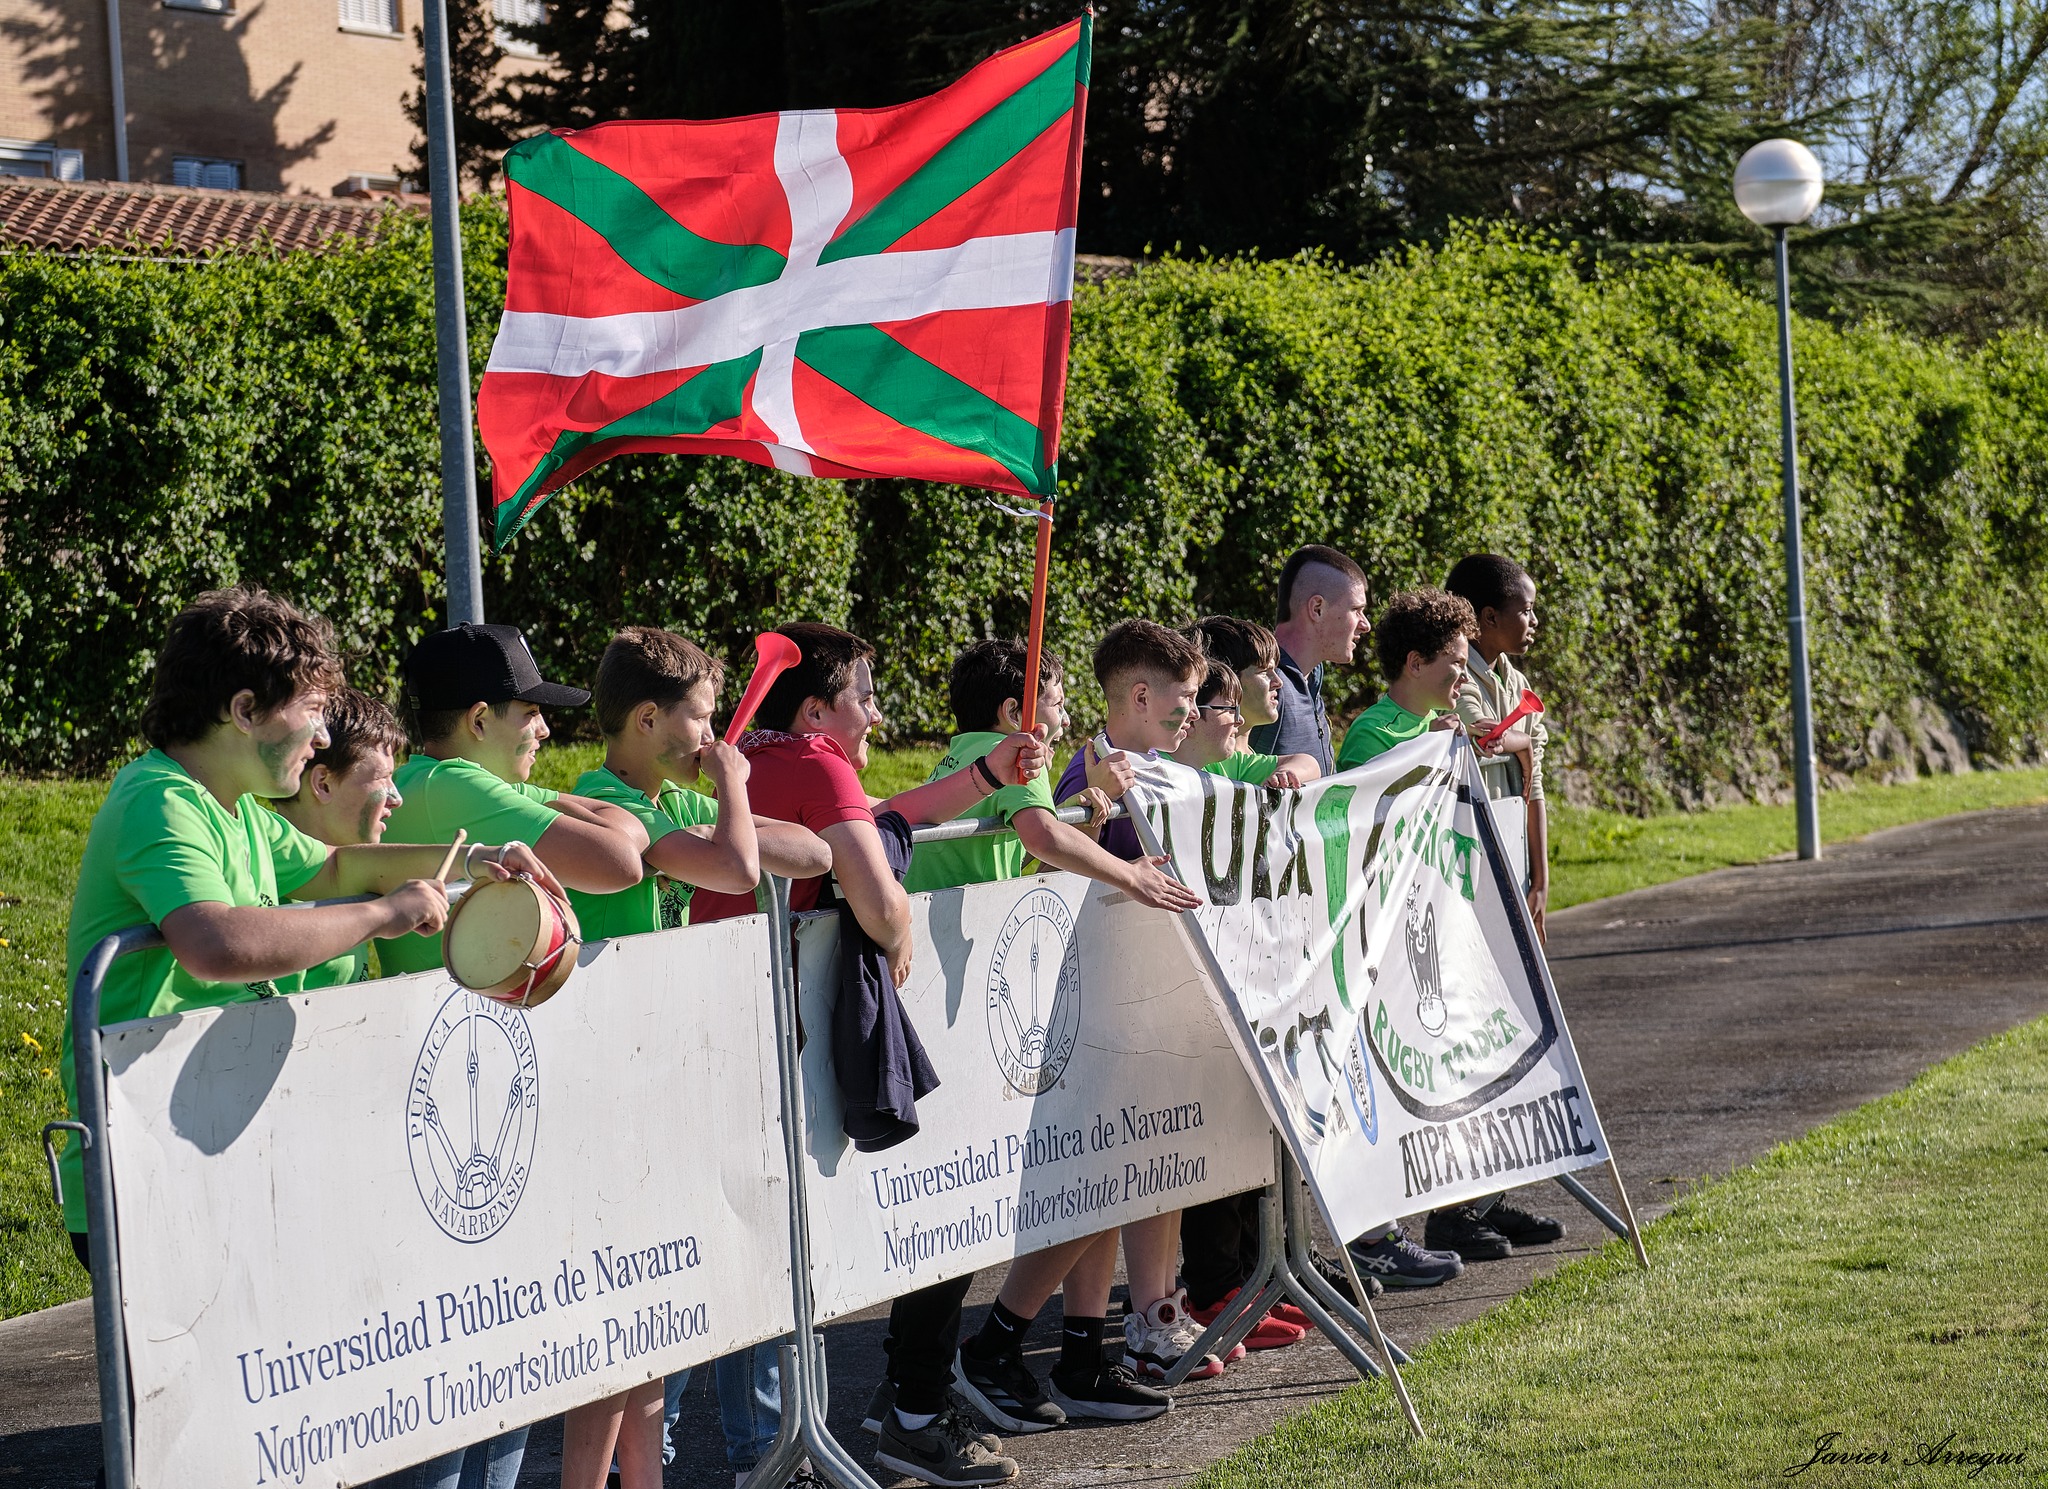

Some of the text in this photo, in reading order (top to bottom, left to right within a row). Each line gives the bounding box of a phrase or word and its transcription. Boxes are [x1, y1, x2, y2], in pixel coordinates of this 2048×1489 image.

[989, 914, 1021, 1010] PUBLICA
[1031, 896, 1079, 993] UNIVERSITAS
[410, 1017, 451, 1141] PUBLICA
[1000, 1034, 1073, 1091] NAVARRENSIS
[1373, 999, 1437, 1093] RUGBY
[429, 1161, 526, 1237] NAVARRENSIS
[872, 1098, 1204, 1210] Universidad Pública de Navarra
[1398, 1125, 1464, 1198] AUPA
[883, 1151, 1208, 1275] Nafarroako Unibertsitate Publikoa
[237, 1233, 702, 1405] Universidad Pública de Navarra
[254, 1301, 710, 1486] Nafarroako Unibertsitate Publikoa
